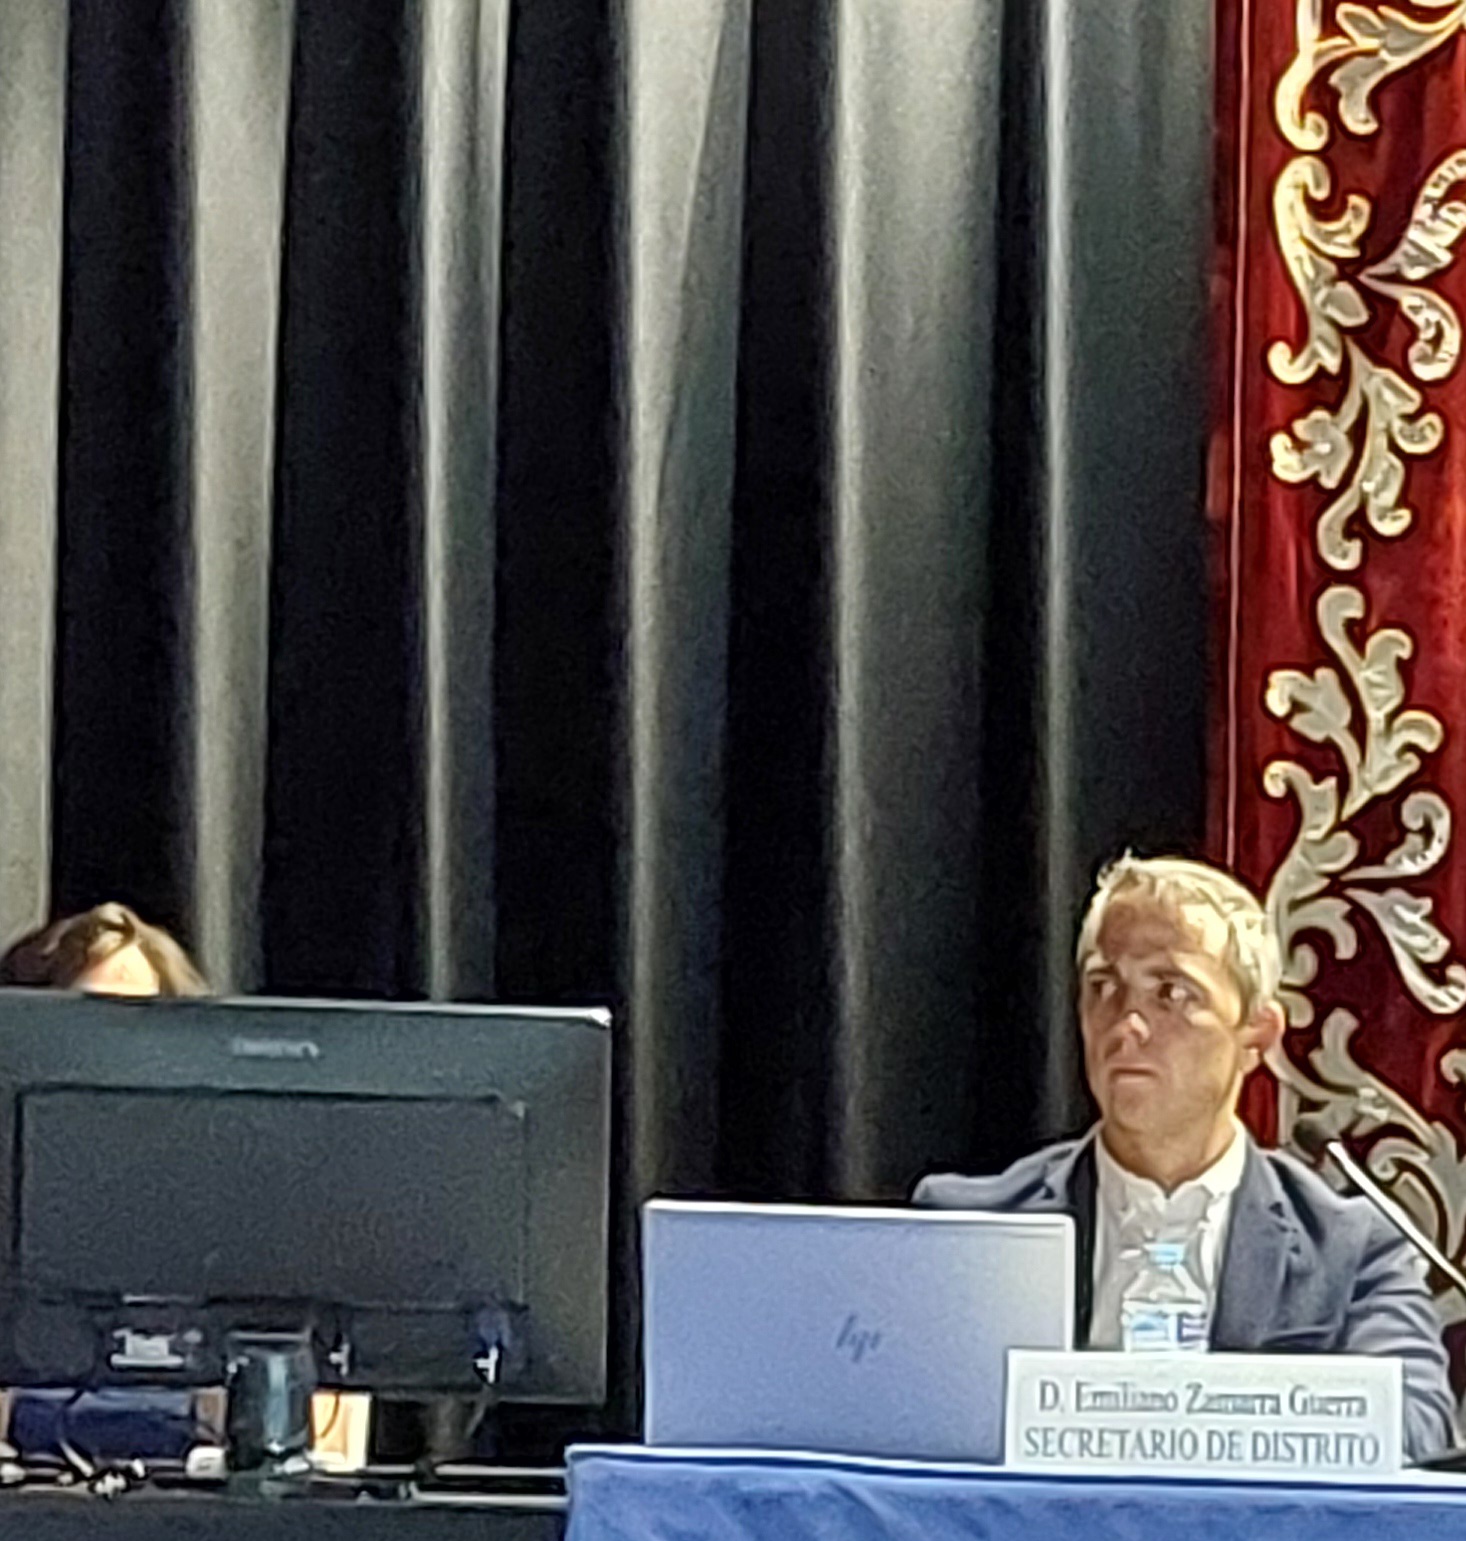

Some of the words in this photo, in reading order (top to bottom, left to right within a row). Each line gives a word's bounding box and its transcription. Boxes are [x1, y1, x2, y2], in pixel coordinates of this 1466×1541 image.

[1039, 1379, 1065, 1413] D.
[1025, 1426, 1198, 1461] SECRETARIO
[1206, 1430, 1243, 1463] DE
[1251, 1431, 1380, 1465] DISTRITO
